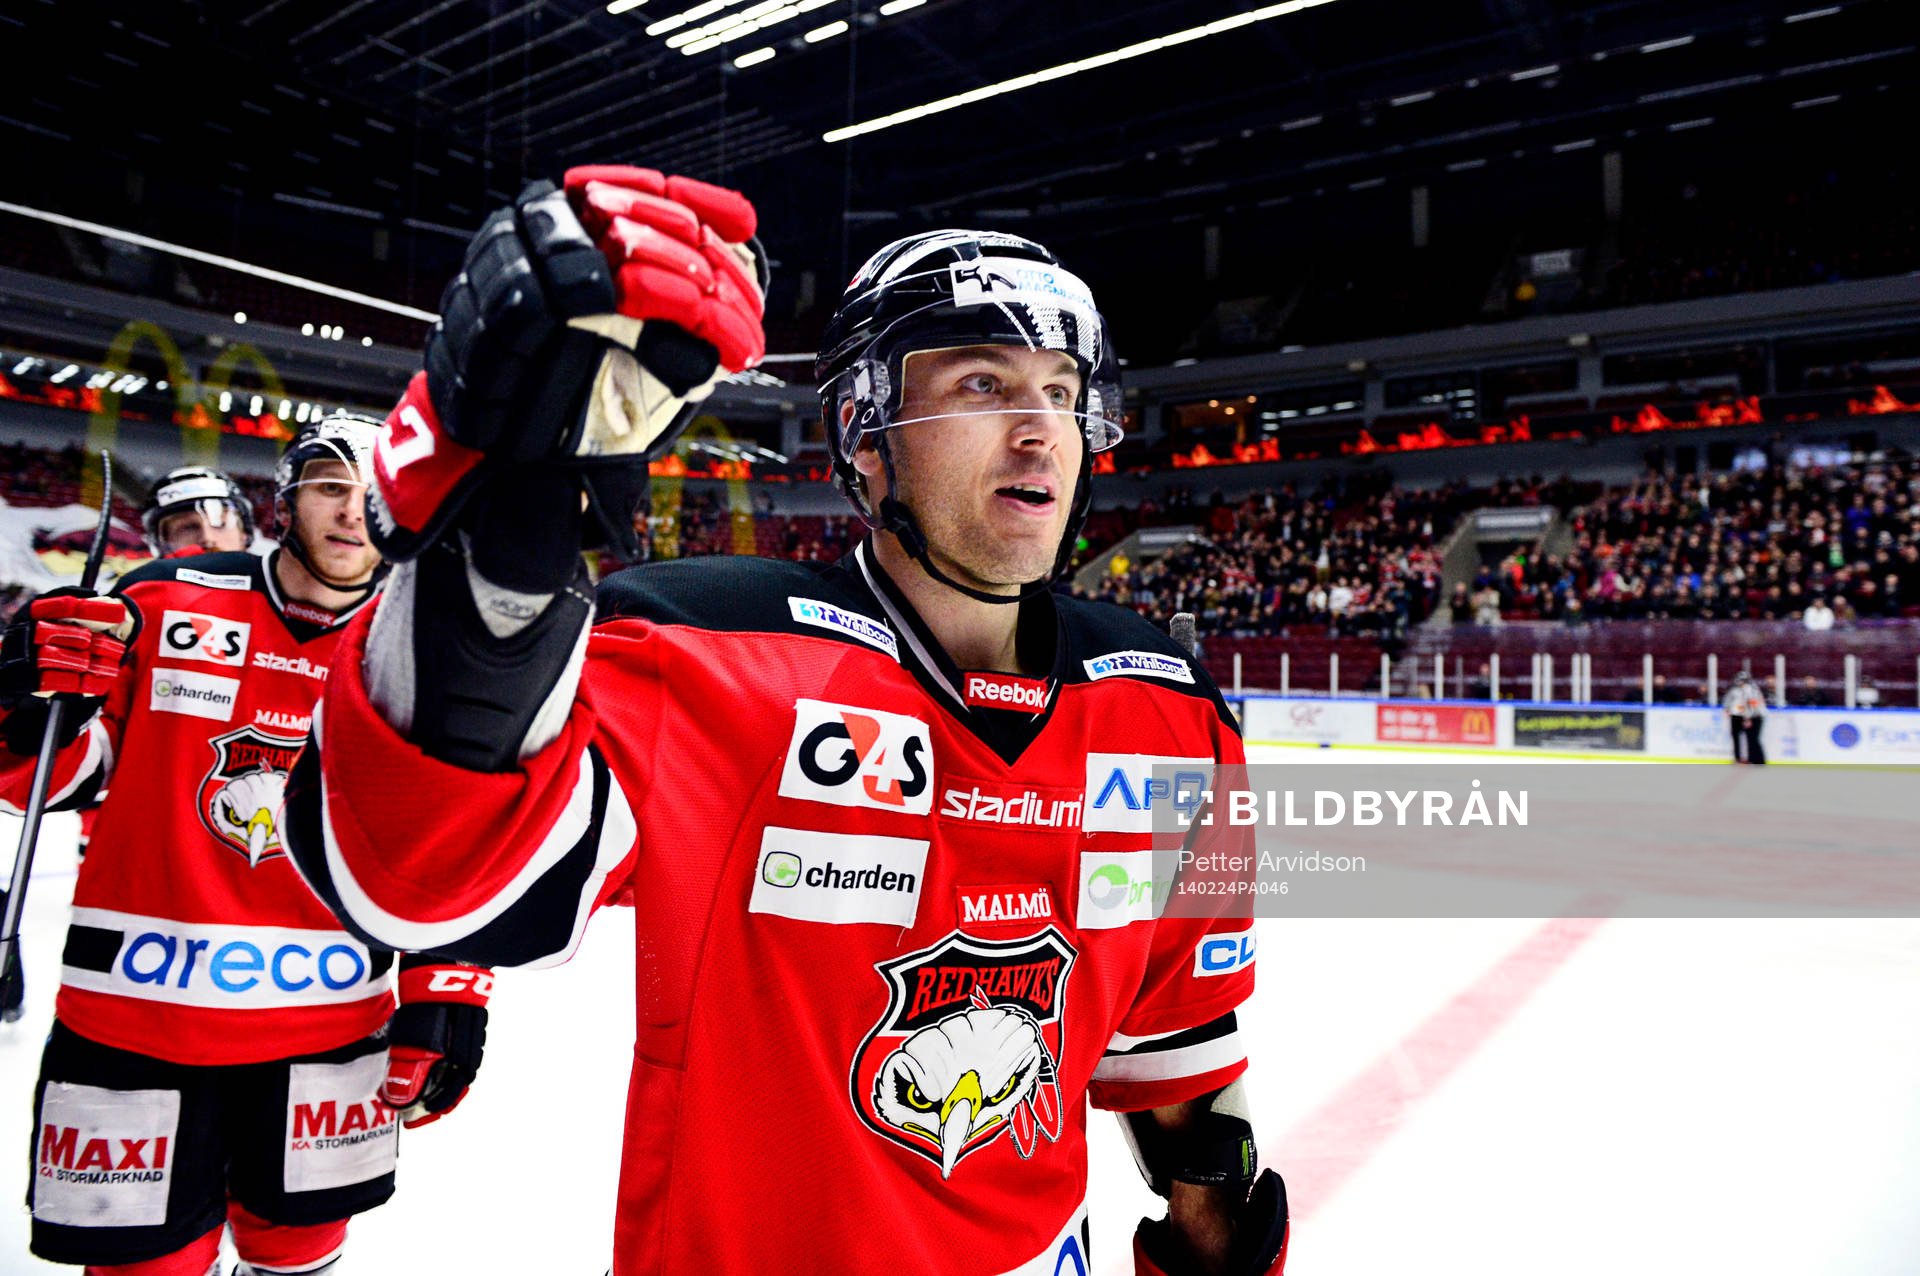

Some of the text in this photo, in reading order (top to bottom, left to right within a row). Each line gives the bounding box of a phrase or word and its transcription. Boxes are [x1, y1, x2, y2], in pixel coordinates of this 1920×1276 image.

[287, 603, 334, 625] Reebok
[166, 617, 240, 661] G4S
[172, 684, 231, 704] charden
[969, 678, 1044, 708] Reebok
[799, 712, 927, 806] G4S
[940, 787, 1083, 828] stadium
[805, 862, 915, 893] charden
[962, 888, 1052, 922] MALMÖ
[122, 932, 365, 993] areco
[906, 956, 1061, 1022] REDHAWKS
[40, 1124, 168, 1171] MAXI
[56, 1169, 164, 1184] STORMARKNAD
